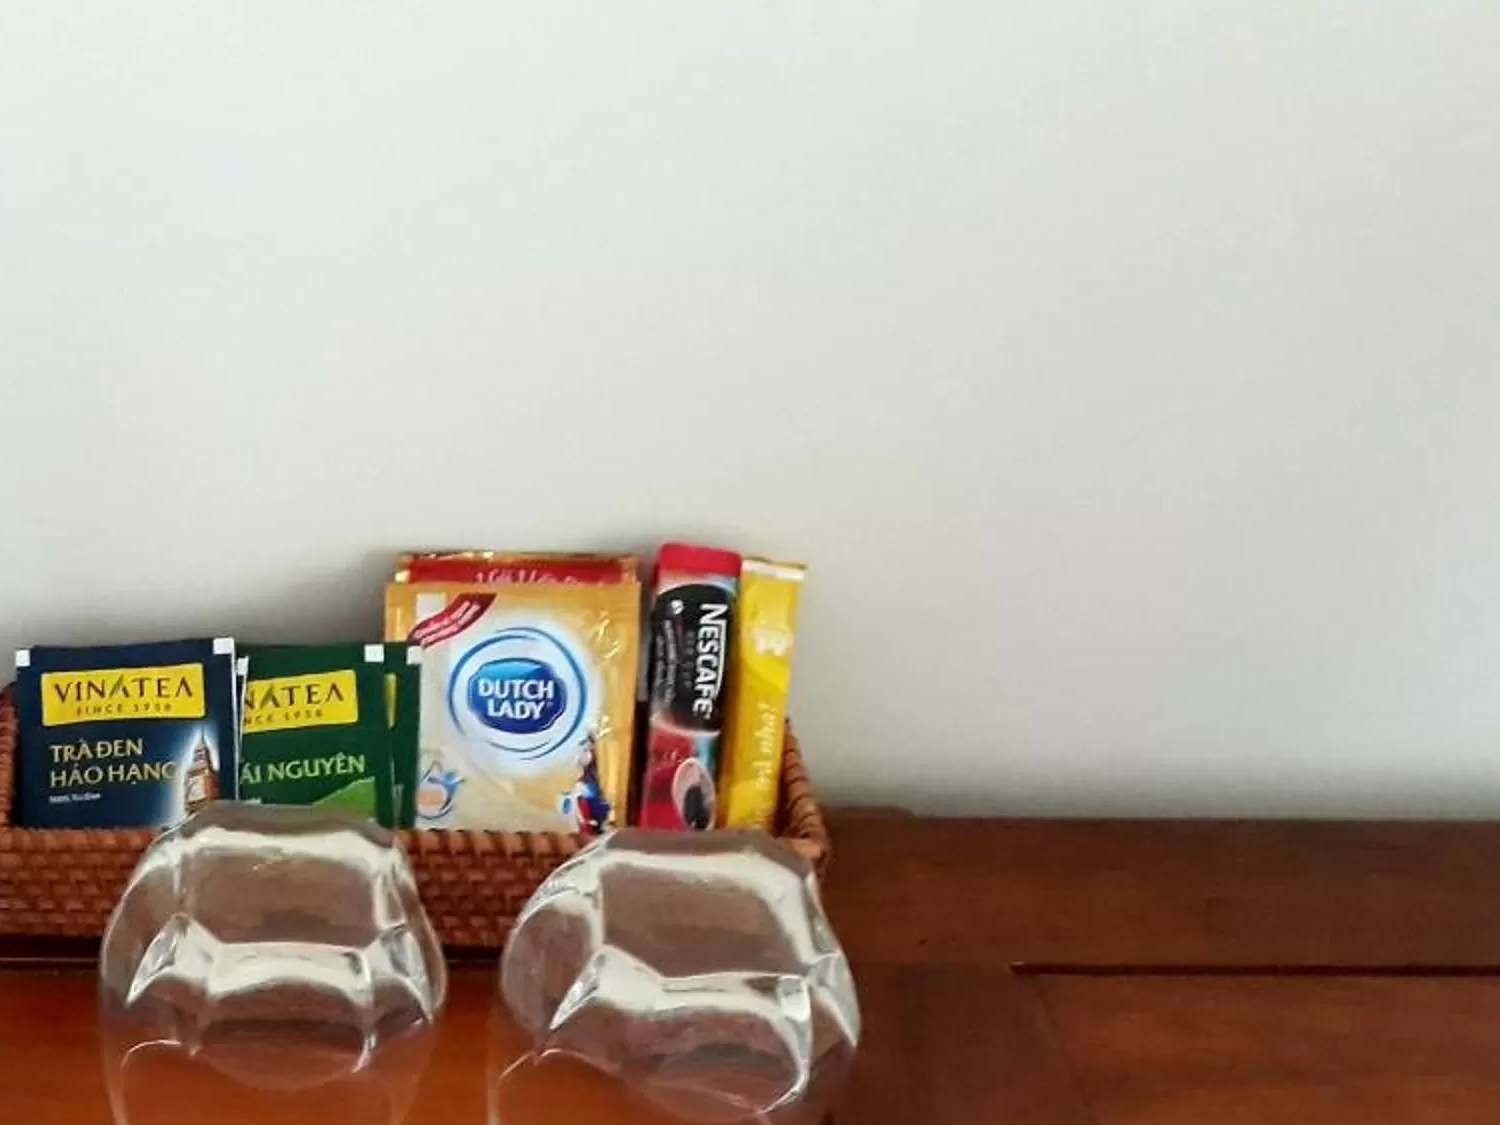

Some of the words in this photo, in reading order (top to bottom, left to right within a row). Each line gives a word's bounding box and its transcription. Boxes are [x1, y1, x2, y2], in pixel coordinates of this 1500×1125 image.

[243, 682, 345, 711] NATEA
[478, 680, 555, 700] DUTCH
[76, 704, 123, 717] SINCE
[487, 700, 546, 719] LADY
[243, 715, 274, 726] NCE
[240, 758, 262, 785] ÁI
[267, 752, 366, 782] NGUYÊN
